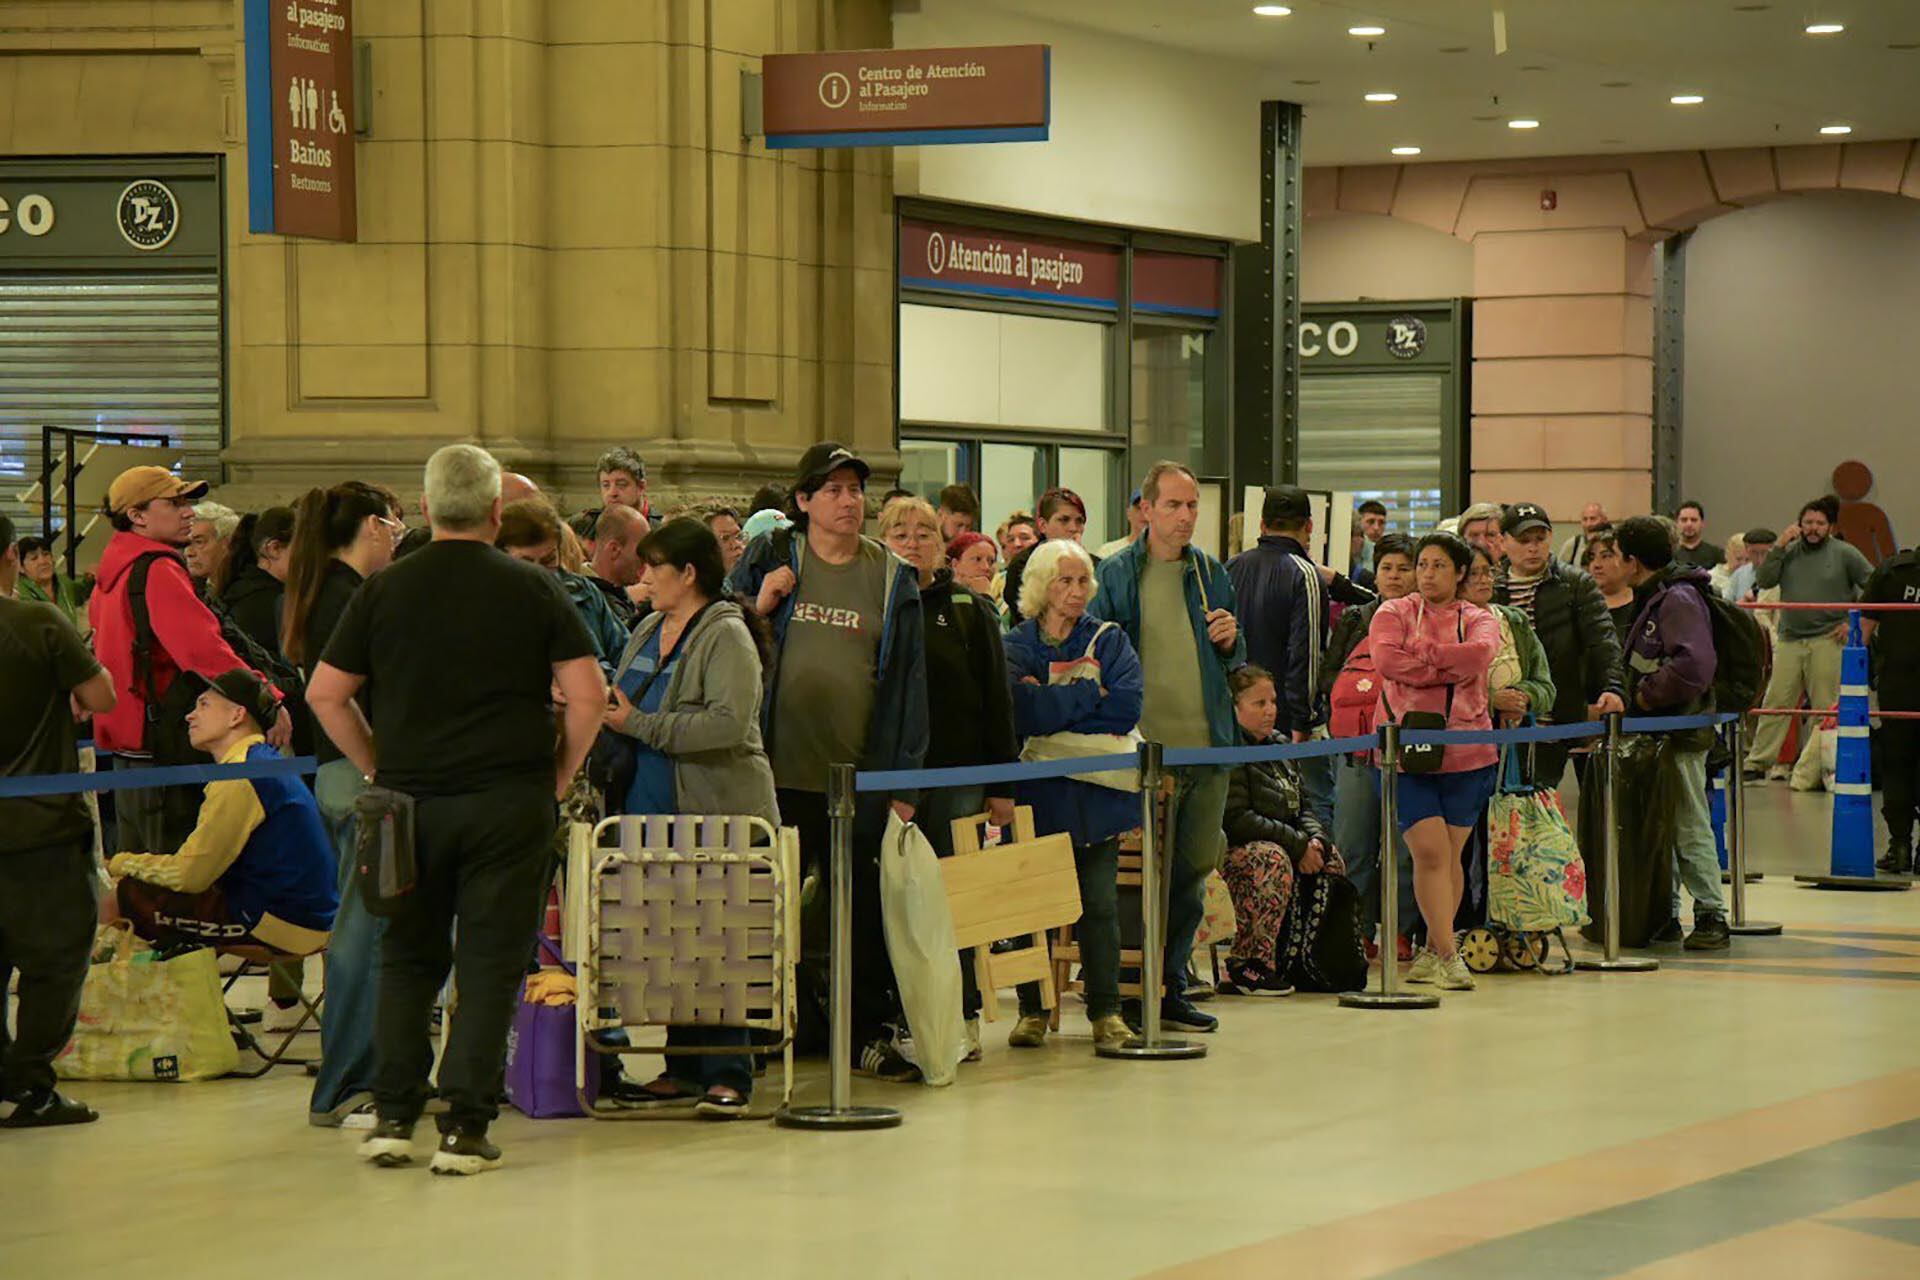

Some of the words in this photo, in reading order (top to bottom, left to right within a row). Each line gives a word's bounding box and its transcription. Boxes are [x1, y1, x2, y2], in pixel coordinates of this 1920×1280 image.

[287, 1, 297, 22] al
[299, 7, 345, 34] pasajero
[858, 66, 901, 82] Centro
[906, 65, 923, 80] de
[927, 62, 986, 79] Atención
[859, 82, 872, 97] al
[874, 82, 929, 100] Pasajero
[859, 101, 908, 112] Information
[290, 139, 332, 168] Baños
[291, 173, 332, 193] Restrooms
[948, 240, 1012, 275] Atención
[1015, 247, 1028, 278] al
[1030, 252, 1084, 290] pasajero
